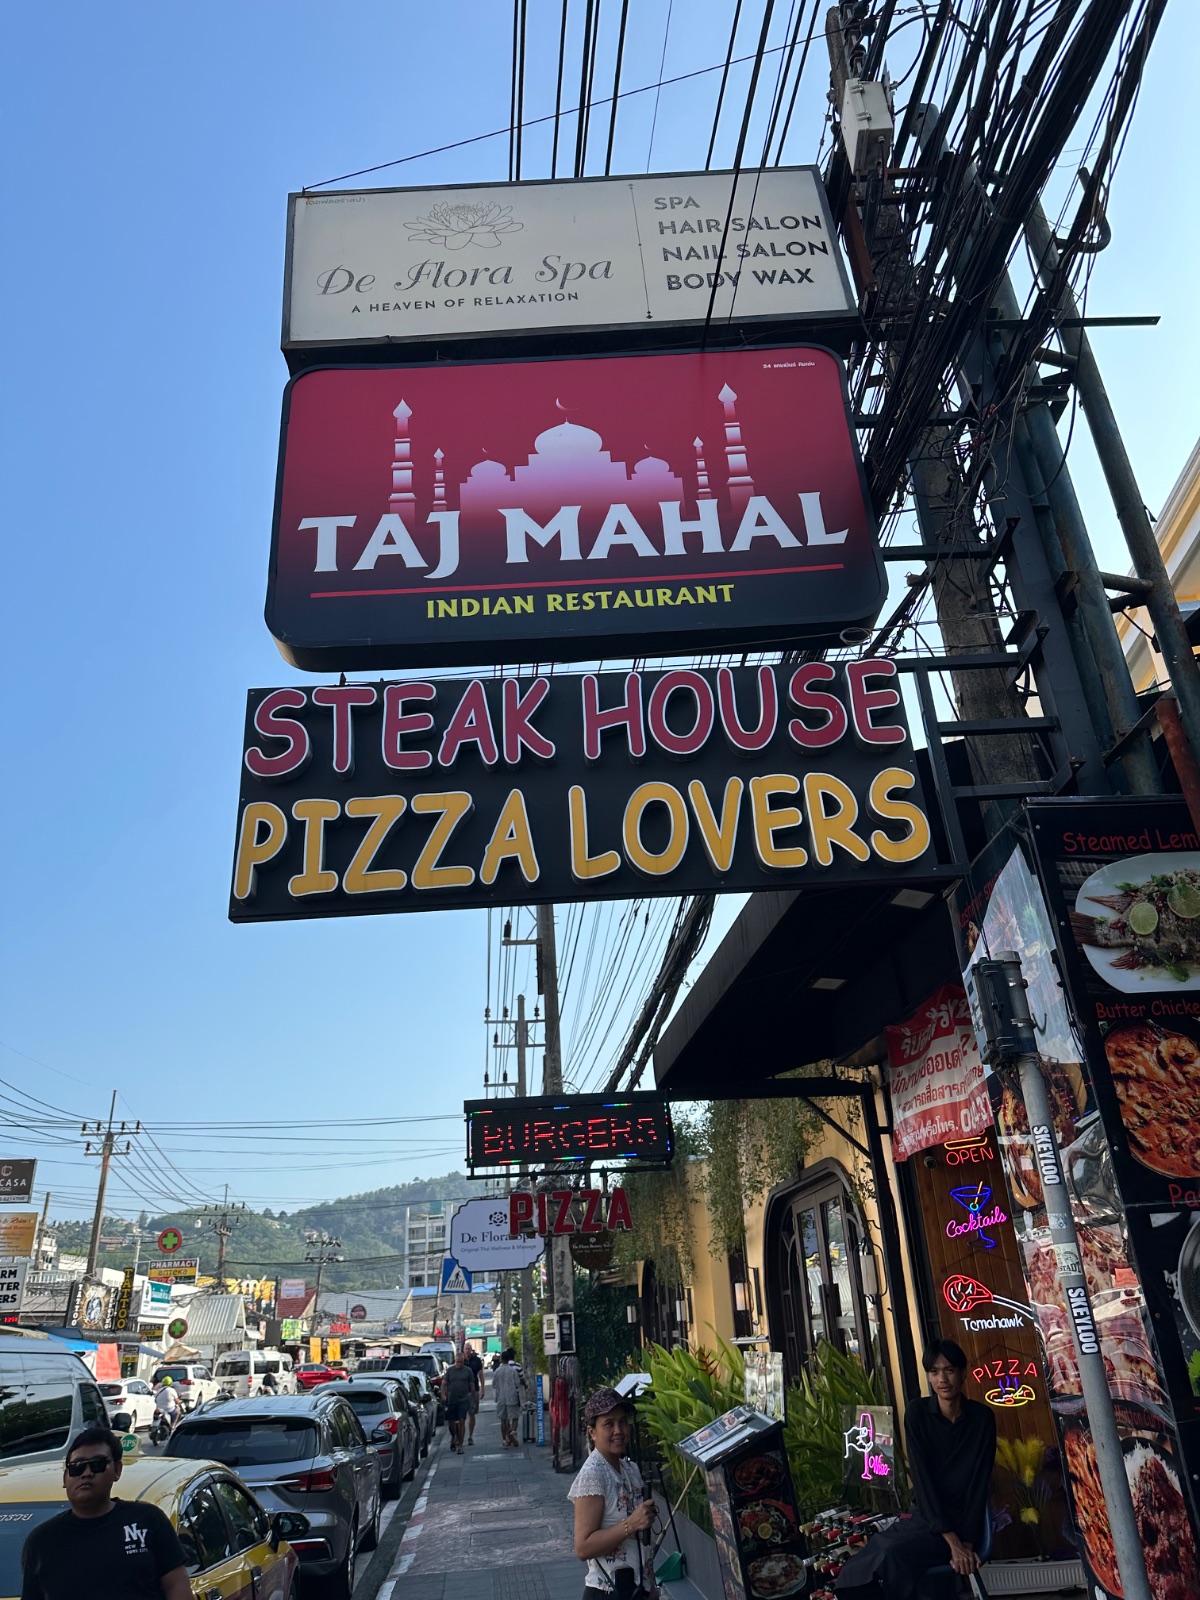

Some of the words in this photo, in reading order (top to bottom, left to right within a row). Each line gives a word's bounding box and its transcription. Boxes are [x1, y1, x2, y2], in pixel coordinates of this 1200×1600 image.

[654, 195, 701, 210] SPA
[658, 218, 722, 235] HAIR
[731, 215, 822, 232] SALON
[662, 244, 727, 262] NAIL
[736, 240, 829, 259] SALON
[316, 264, 376, 296] De
[394, 259, 514, 291] Flora
[534, 254, 614, 290] Spa
[666, 270, 741, 291] BODY
[751, 267, 814, 286] WAX
[351, 304, 361, 314] A
[369, 300, 436, 313] HEAVEN
[444, 298, 465, 308] OF
[474, 292, 579, 306] RELAXATION
[297, 510, 460, 580] TAJ
[497, 491, 849, 564] MAHAL
[427, 594, 535, 619] INDIAN
[546, 583, 736, 612] RESTAURANT
[244, 677, 556, 778] STEAK
[581, 658, 907, 760] HOUSE
[233, 788, 540, 900] PIZZA
[568, 767, 931, 880] LOVERS
[1063, 828, 1152, 852] Steamed
[1095, 1001, 1146, 1019] Butter
[483, 1117, 658, 1155] BURGERS
[945, 1147, 994, 1166] OPEN
[1034, 1125, 1060, 1185] SKEYLOO
[1168, 1183, 1200, 1209] Pa
[509, 1187, 634, 1237] PIZZA
[945, 1205, 1008, 1238] Cocktails
[460, 1232, 477, 1243] De
[480, 1231, 511, 1243] Flora
[150, 1260, 197, 1268] PHARMACY
[71, 1284, 84, 1327] TATTOO
[116, 1268, 133, 1329] TATTOO
[960, 1313, 1025, 1332] Tomahawk
[1068, 1287, 1099, 1354] SKEYLOO
[972, 1359, 1038, 1384] PIZZA
[121, 1439, 137, 1448] GPS
[123, 1522, 148, 1547] NY
